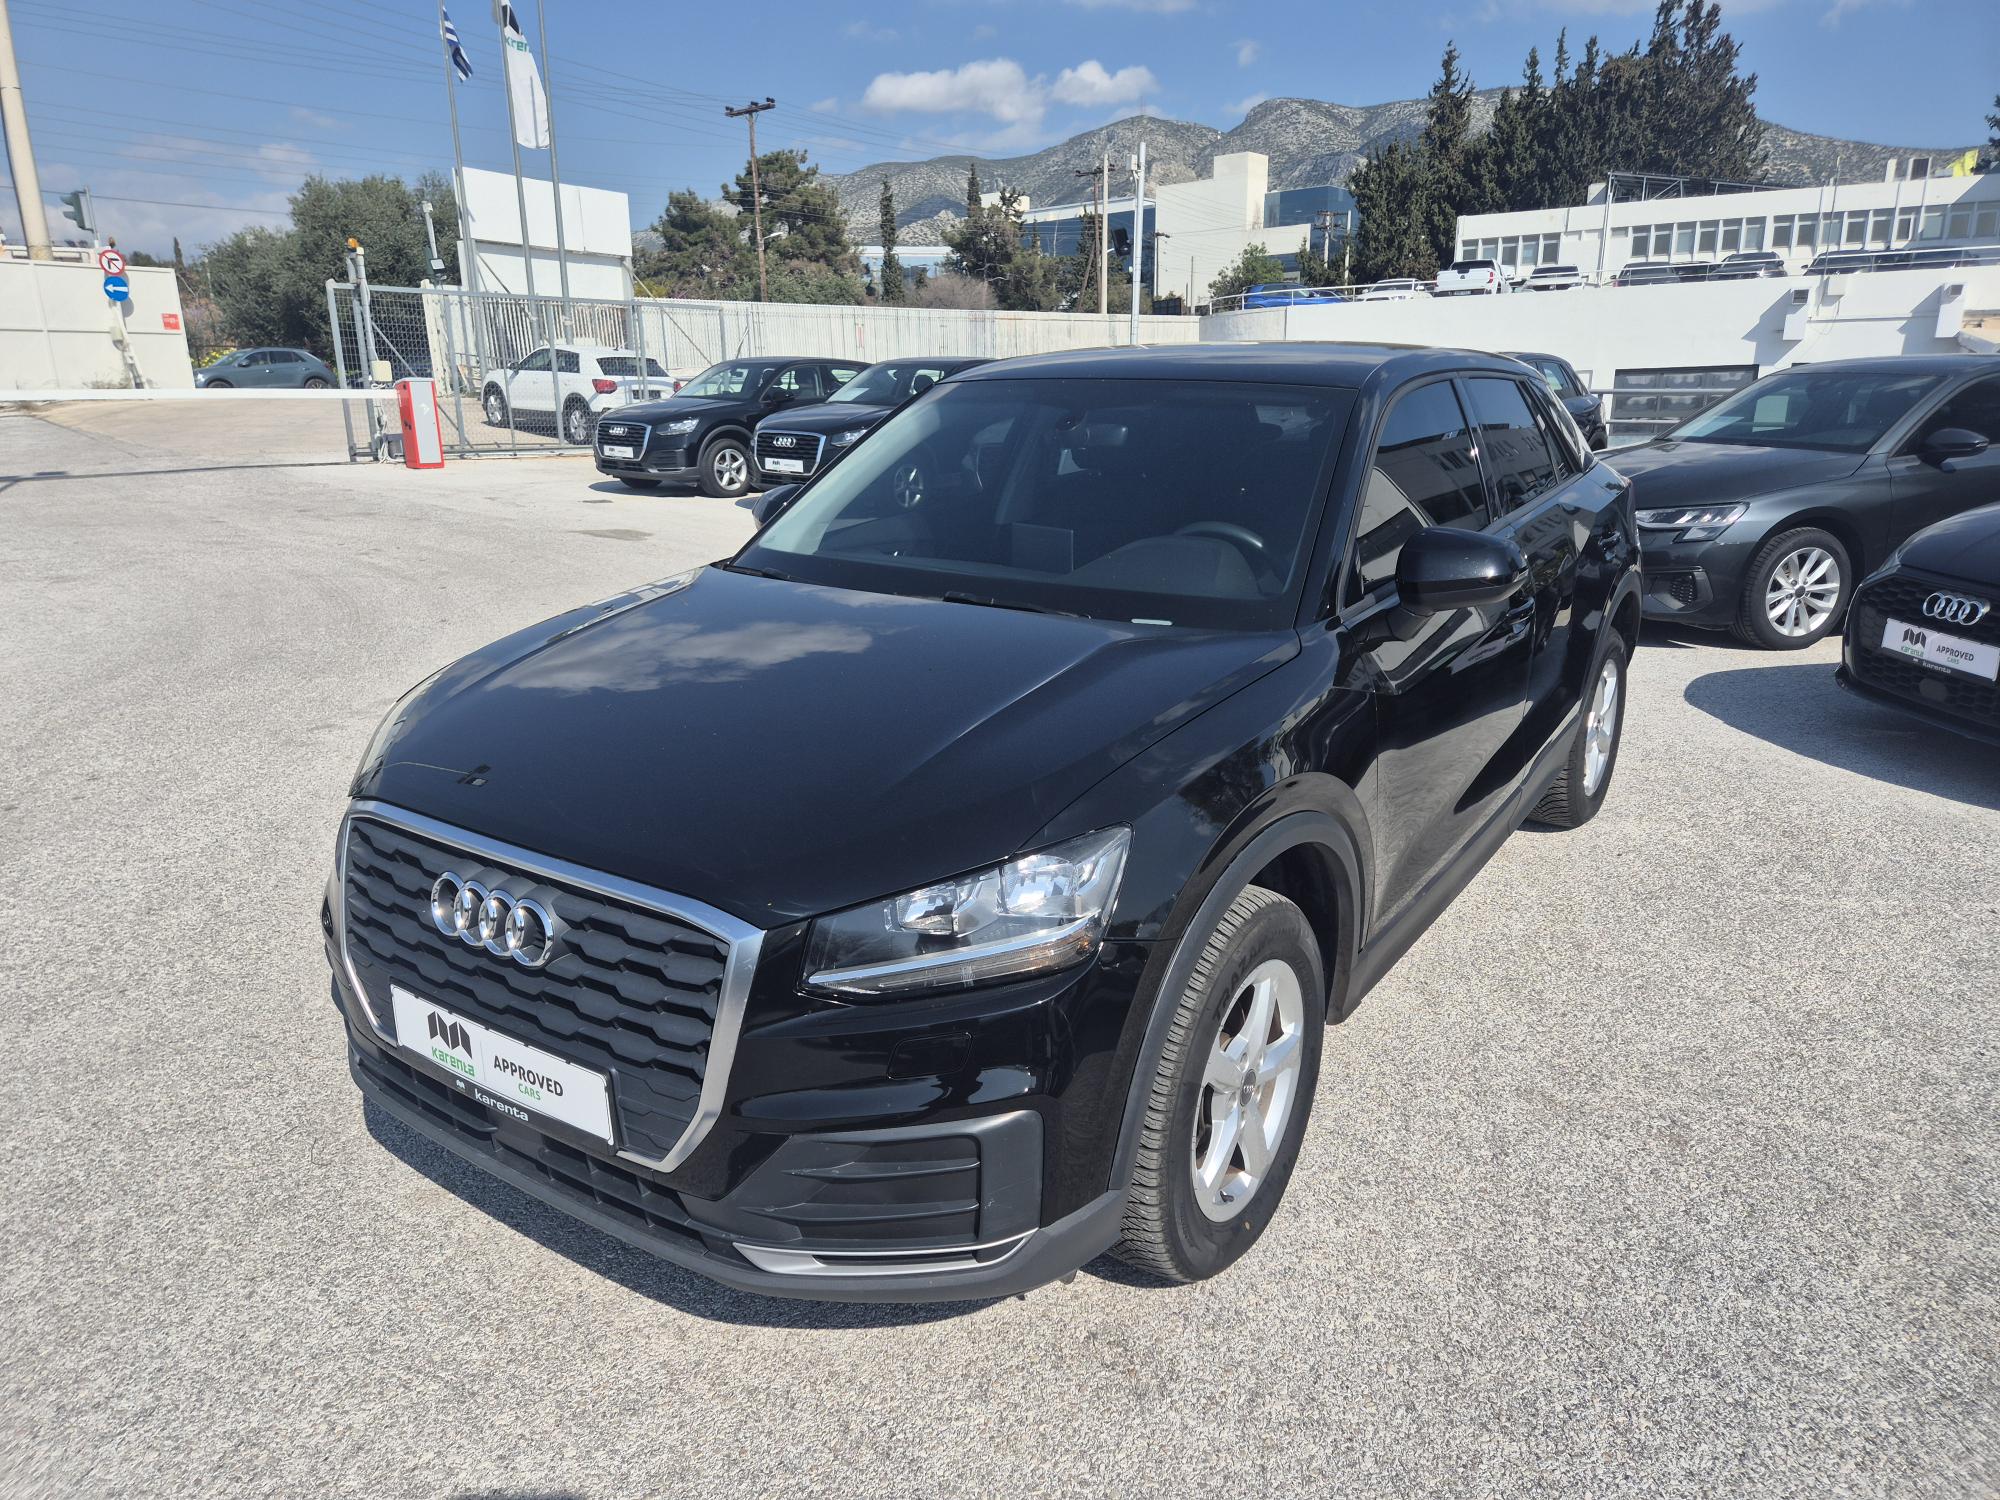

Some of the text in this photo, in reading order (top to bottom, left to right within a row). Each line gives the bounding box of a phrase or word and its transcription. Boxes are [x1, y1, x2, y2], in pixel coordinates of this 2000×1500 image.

[1936, 645, 1975, 662] APPROVED
[1922, 661, 1951, 674] karenta
[431, 1046, 476, 1078] karenta
[493, 1055, 564, 1097] APPROVED
[518, 1082, 542, 1101] CARS
[474, 1088, 529, 1122] karenta
